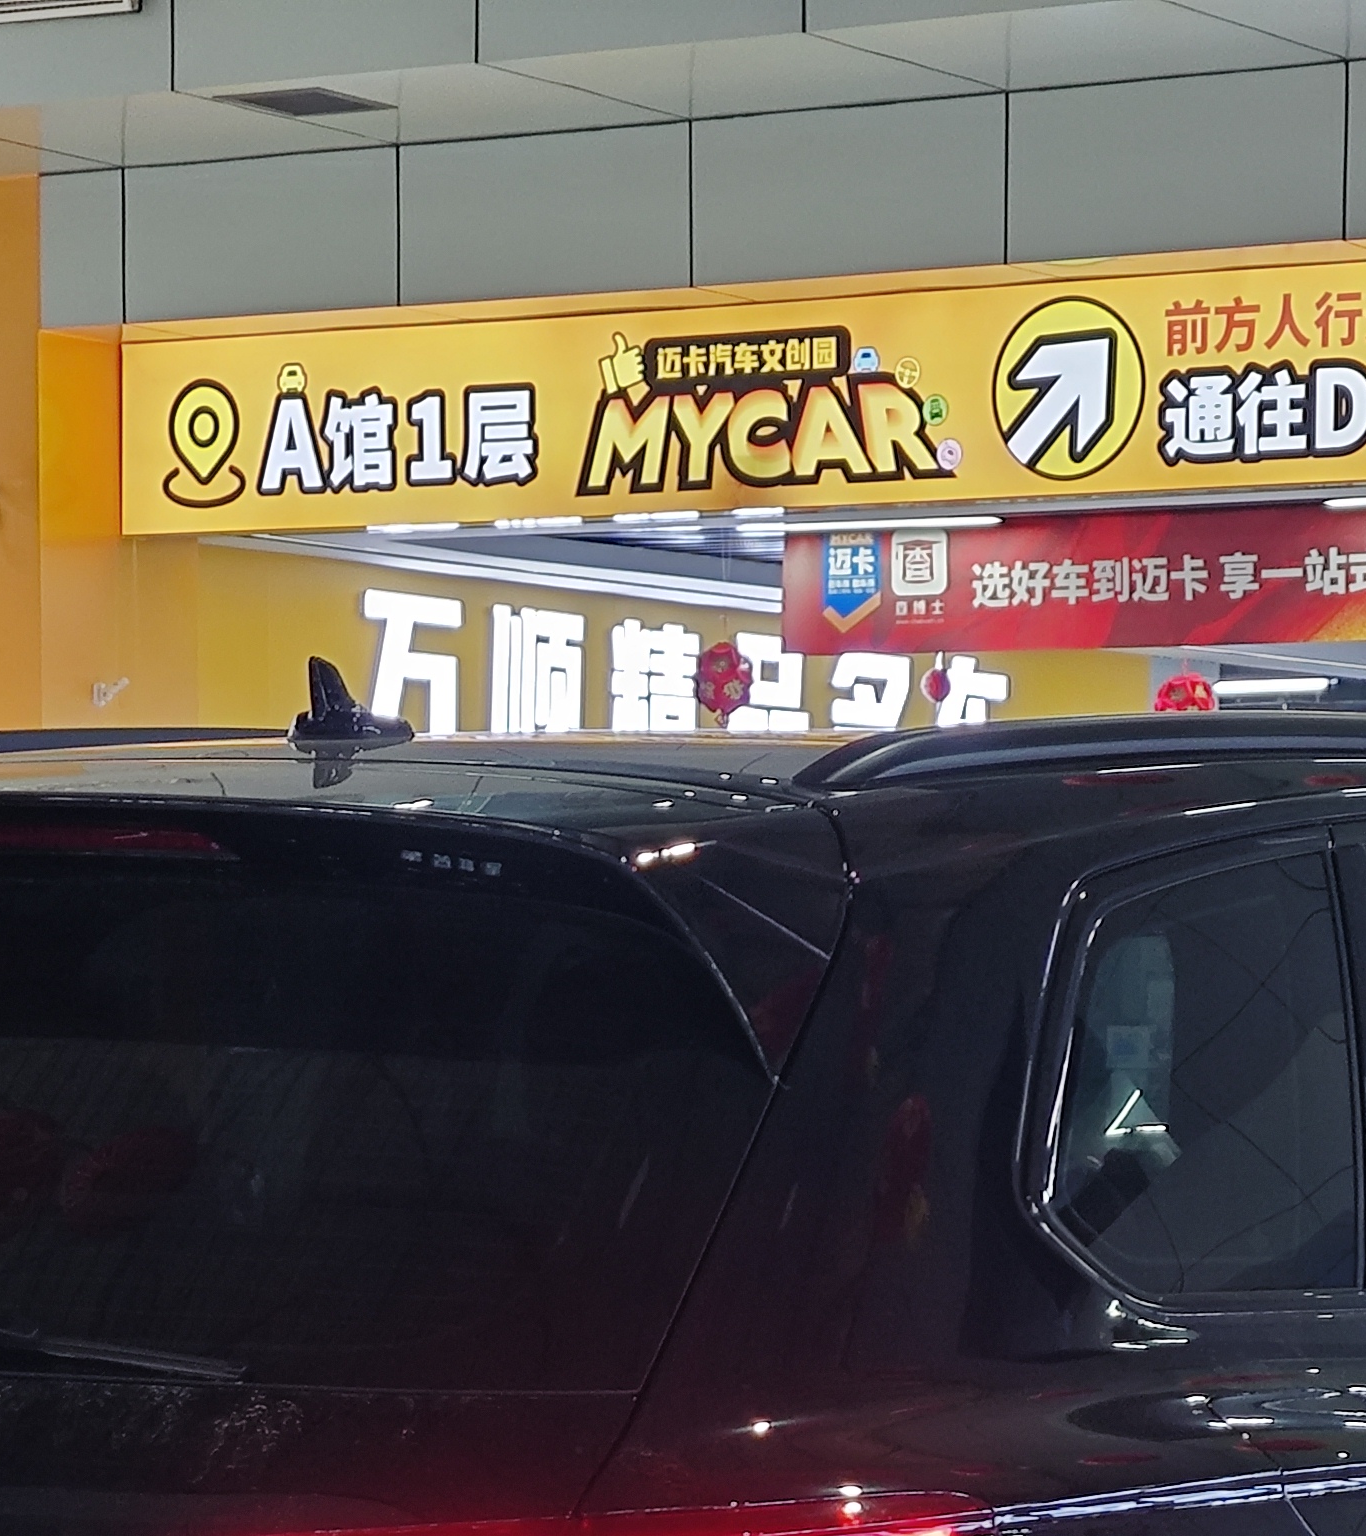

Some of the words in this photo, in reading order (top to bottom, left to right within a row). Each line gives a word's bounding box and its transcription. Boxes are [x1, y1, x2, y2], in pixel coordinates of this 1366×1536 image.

[656, 337, 838, 378] 迈卡汽车文创园
[260, 389, 537, 493] A馆1层
[584, 382, 937, 490] MYCAR
[828, 546, 875, 576] 迈卡
[971, 554, 1209, 609] 选好车到迈卡
